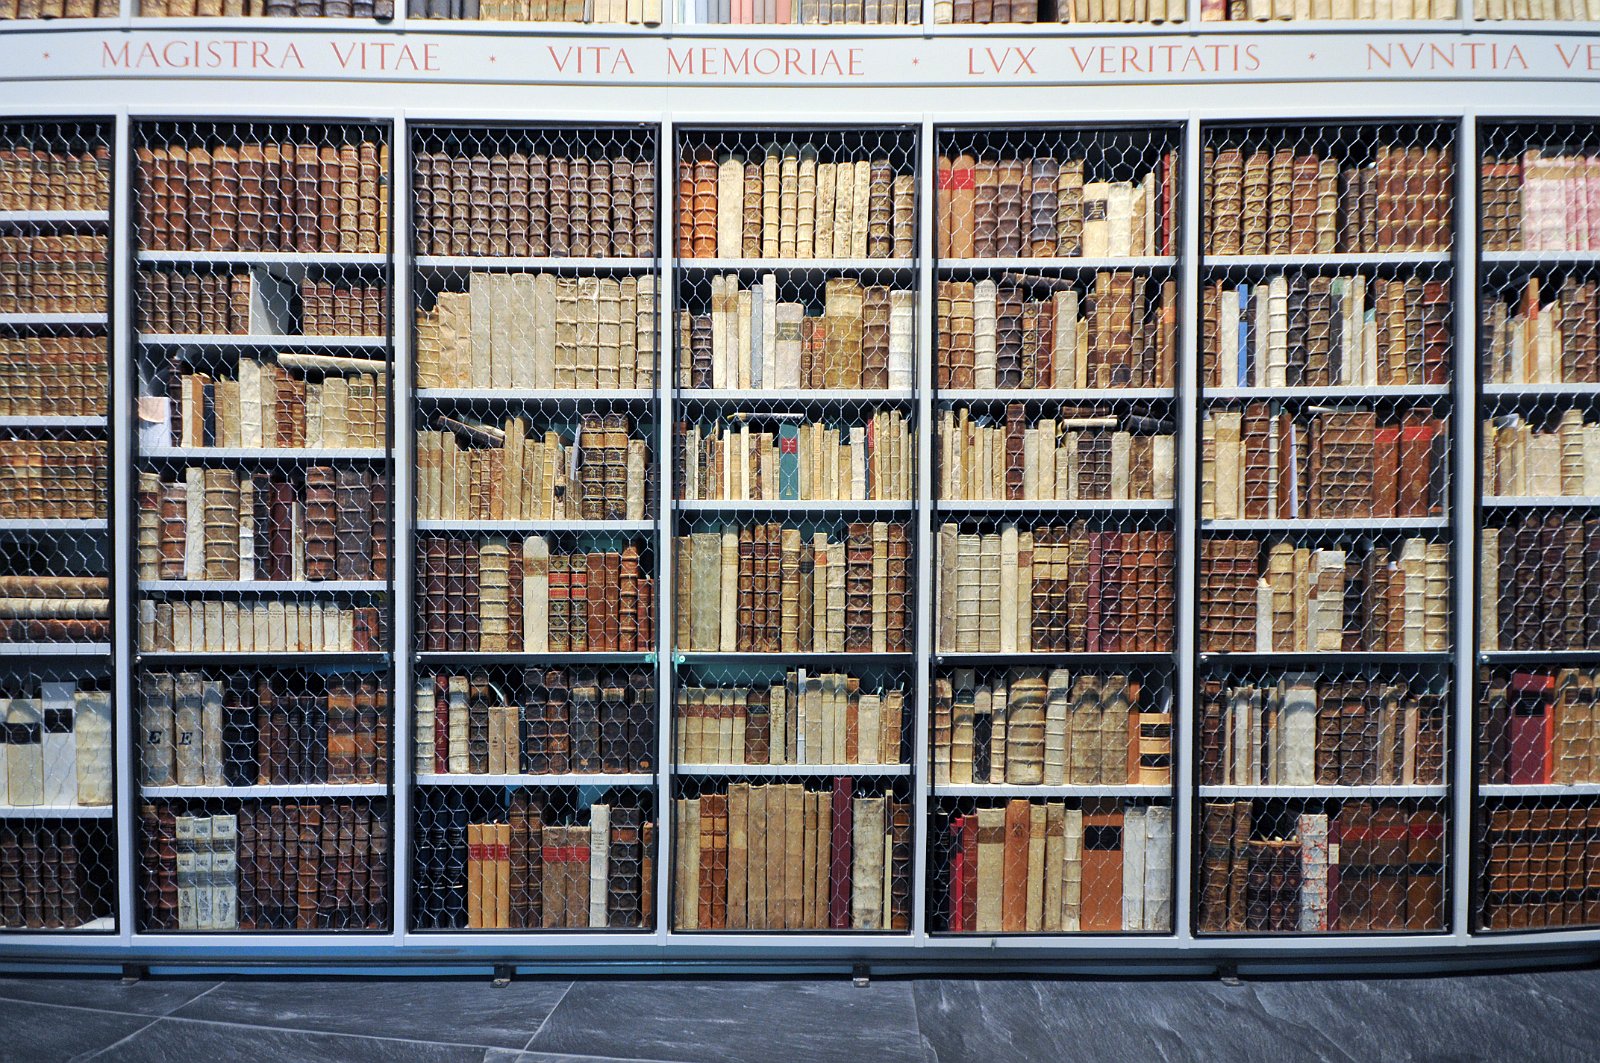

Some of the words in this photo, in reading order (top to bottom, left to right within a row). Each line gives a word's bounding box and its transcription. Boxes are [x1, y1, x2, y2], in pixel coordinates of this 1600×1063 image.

[101, 41, 306, 70] MAGISTRA
[329, 42, 441, 72] VITAE
[547, 46, 636, 75] VITA
[666, 47, 865, 77] MEMORIAE
[967, 48, 1038, 76] LVX
[1069, 44, 1262, 75] VERITATIS
[1366, 43, 1529, 71] NVNTIA
